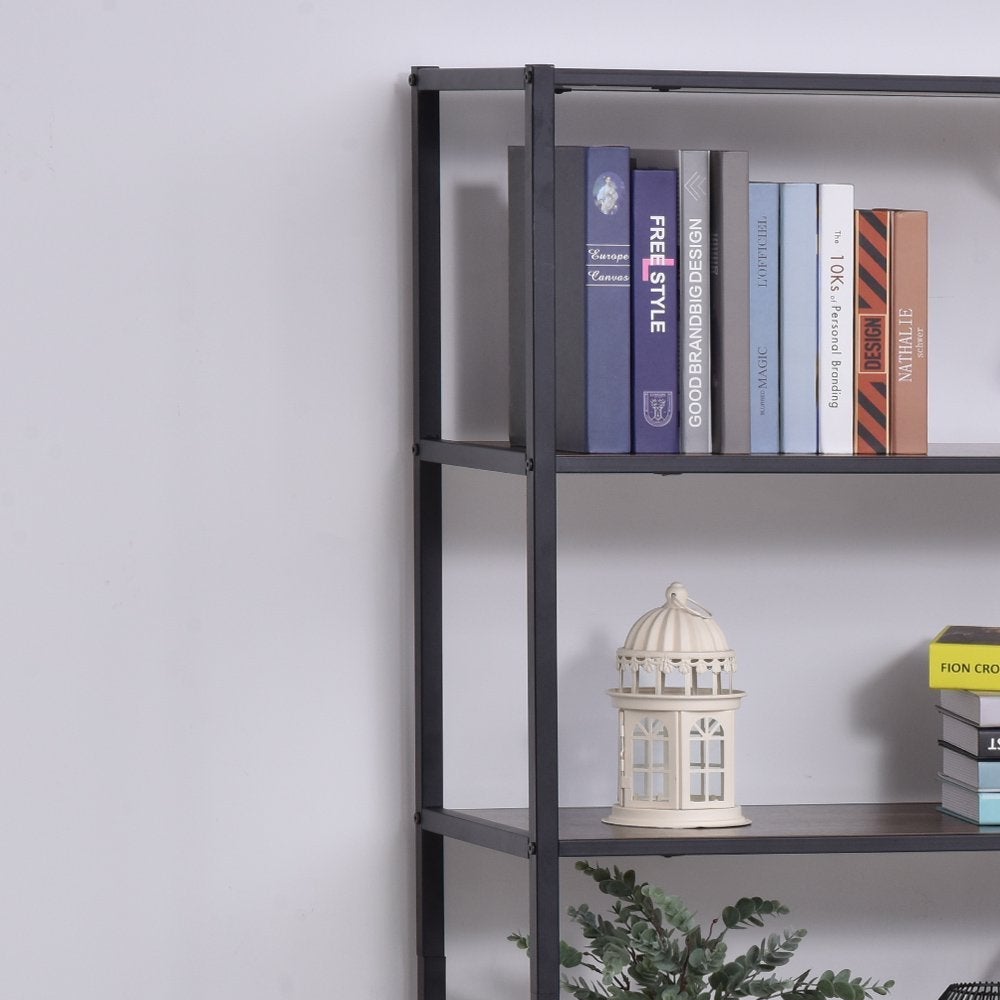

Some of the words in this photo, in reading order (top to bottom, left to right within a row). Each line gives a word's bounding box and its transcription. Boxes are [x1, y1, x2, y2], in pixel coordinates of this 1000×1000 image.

[587, 248, 630, 263] Europe
[650, 215, 666, 266] FREE
[688, 218, 703, 284] DESIGN
[757, 215, 769, 288] L'OFFICIEL
[833, 230, 843, 244] The
[587, 270, 630, 282] Canvas
[829, 255, 845, 292] 10Ks
[650, 272, 666, 333] STYLE
[829, 295, 837, 304] of
[831, 305, 842, 355] Personal
[863, 317, 882, 371] DESIGN
[898, 308, 913, 383] NATHALIE
[757, 346, 768, 389] MAGIC
[828, 360, 842, 409] Branding
[688, 377, 703, 428] GOOD
[940, 662, 971, 675] FION
